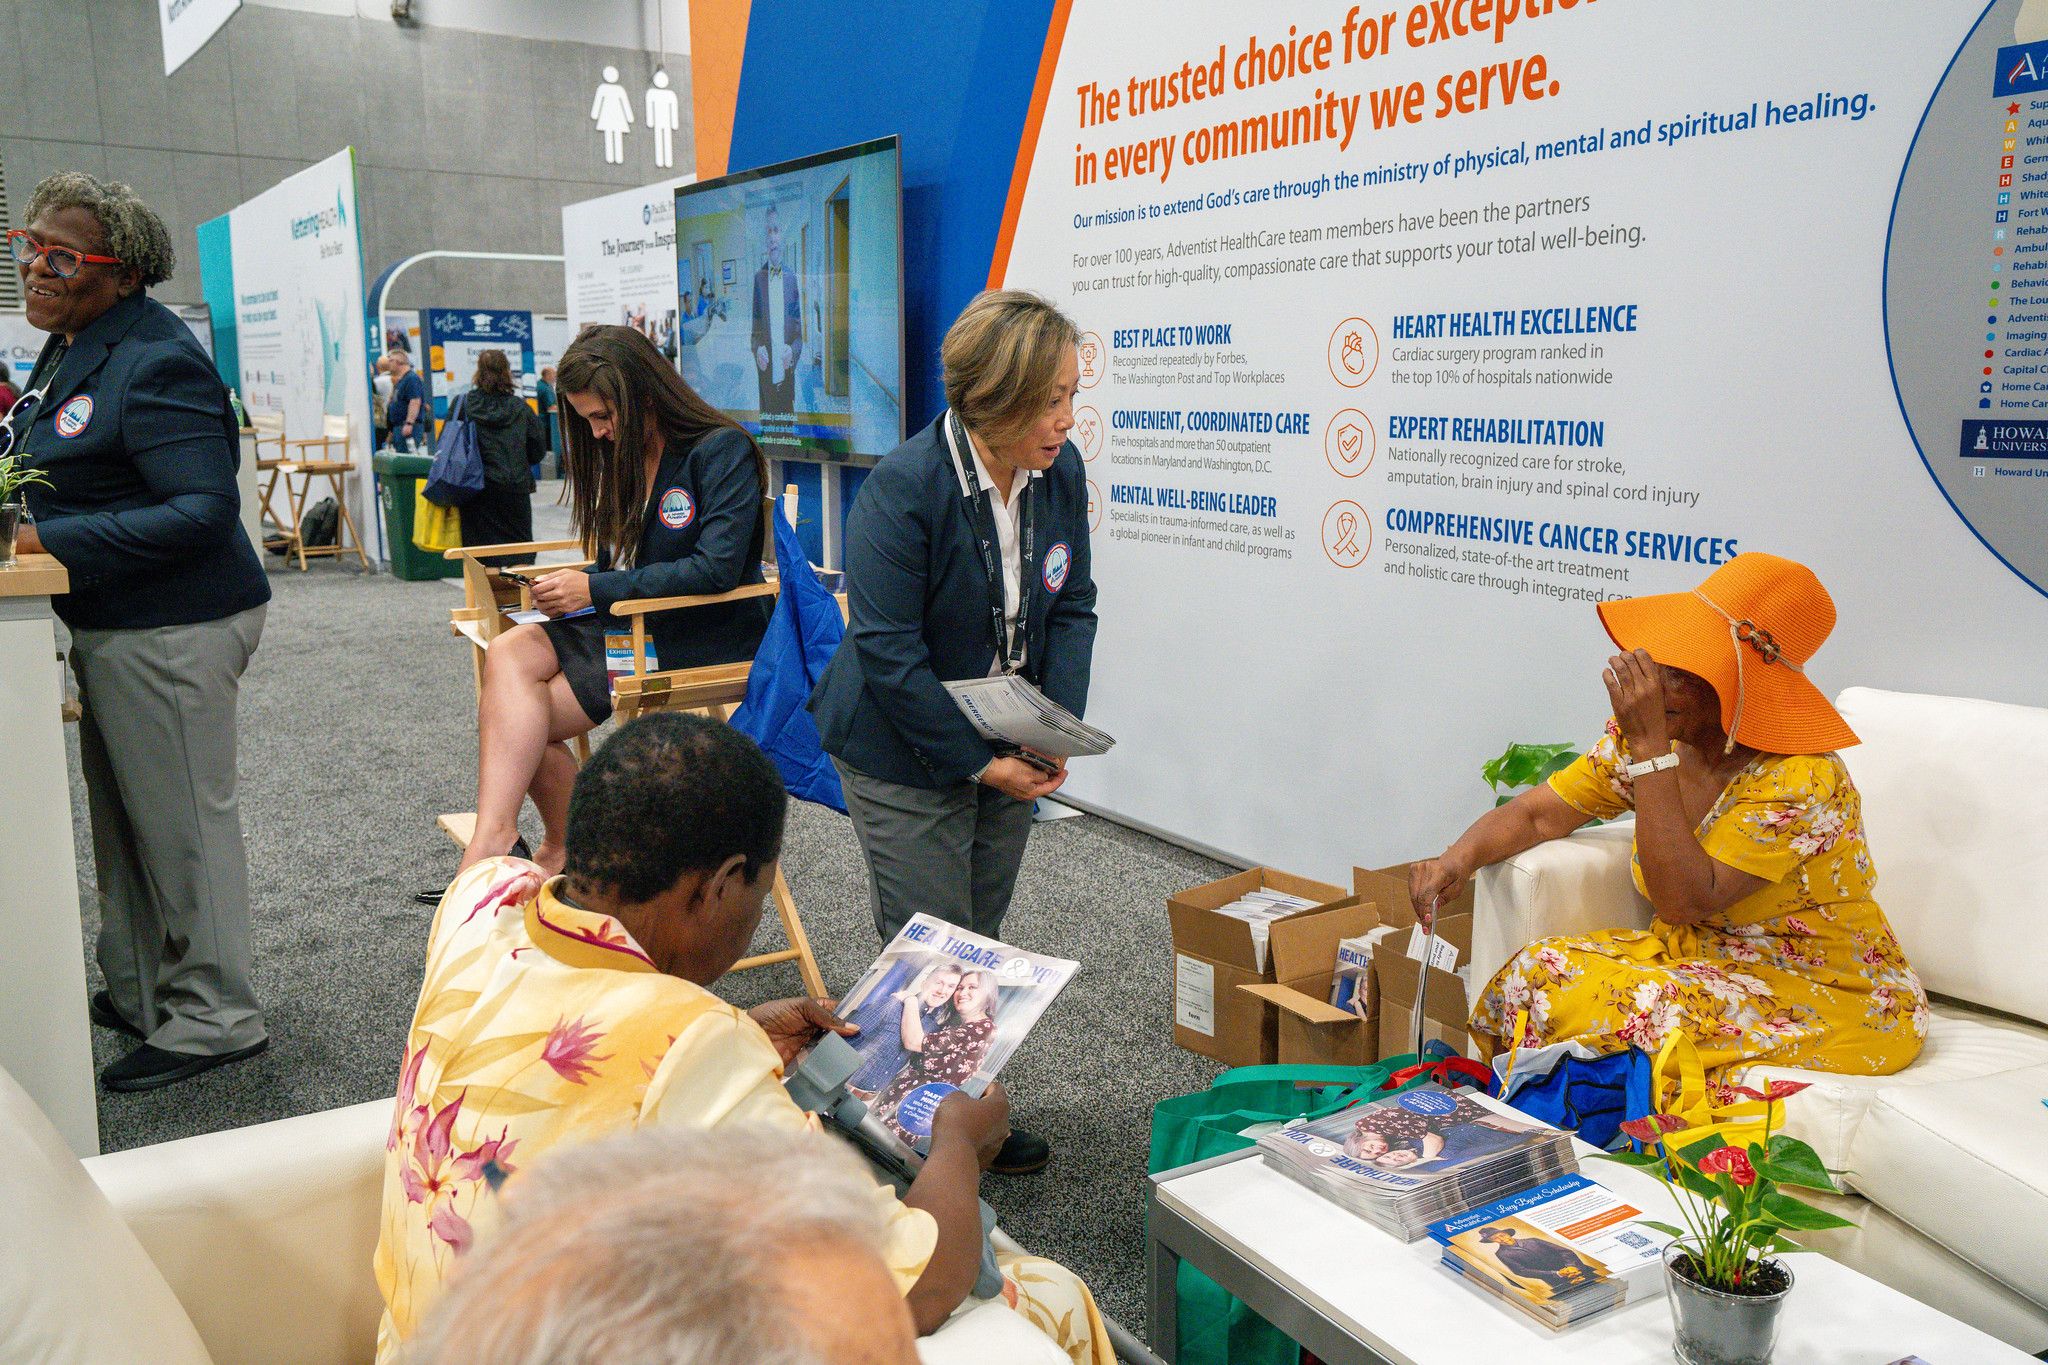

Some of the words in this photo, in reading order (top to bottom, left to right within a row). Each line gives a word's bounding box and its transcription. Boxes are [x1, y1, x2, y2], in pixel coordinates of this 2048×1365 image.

[1077, 81, 1120, 128] The
[1127, 44, 1226, 117] trusted
[1234, 25, 1332, 90] choice
[1342, 5, 1397, 64] for
[1406, 0, 1597, 48] excep
[1075, 143, 1097, 186] in
[1104, 135, 1176, 184] every
[1182, 90, 1361, 166] community
[1369, 81, 1425, 130] we
[1435, 54, 1560, 118] serve.
[1074, 214, 1093, 229] Our
[1095, 208, 1135, 226] mission
[1138, 204, 1146, 220] is
[1164, 193, 1203, 216] extend
[1206, 188, 1240, 209] God's
[1243, 188, 1270, 204] care
[1273, 174, 1330, 199] through
[1334, 170, 1359, 190] the
[1363, 162, 1429, 186] ministry
[1433, 153, 1451, 176] of
[1454, 141, 1530, 178] physical,
[1536, 128, 1604, 160] mental
[1610, 120, 1652, 149] and
[1658, 103, 1758, 146] spiritual
[1765, 92, 1876, 126] healing.
[2018, 208, 2039, 218] Fort
[1073, 254, 1088, 268] For
[1090, 254, 1112, 266] over
[1115, 248, 1132, 264] 100
[1134, 248, 1164, 266] years,
[1166, 238, 1217, 258] Adventist
[1220, 230, 1286, 251] HealthCare
[1289, 228, 1322, 244] team
[1326, 218, 1394, 240] members
[1398, 213, 1434, 232] have
[1439, 208, 1478, 228] been
[1483, 202, 1510, 222] the
[1515, 196, 1590, 224] partners
[602, 240, 616, 256] The
[616, 238, 645, 257] Journey
[1072, 281, 1090, 296] you
[1112, 274, 1135, 288] trust
[1137, 270, 1152, 286] for
[1155, 264, 1221, 288] high-quality,
[1224, 256, 1316, 280] compassionate
[1320, 255, 1348, 270] care
[1352, 248, 1381, 267] that
[1385, 243, 1452, 268] supports
[1456, 241, 1493, 264] your
[1497, 231, 1536, 254] total
[1541, 225, 1646, 250] well-being.
[2010, 297, 2028, 306] The
[1393, 314, 1446, 339] HEART
[1450, 310, 1516, 337] HEALTH
[1520, 304, 1638, 335] EXCELLENCE
[1114, 329, 1140, 349] BEST
[1142, 327, 1176, 348] PLACE
[1178, 326, 1193, 346] TO
[1195, 324, 1232, 345] WORK
[2006, 331, 2048, 342] Imaging
[1113, 354, 1158, 369] Recognized
[1160, 352, 1202, 368] repeatedly
[1216, 351, 1248, 365] Forbes,
[1392, 346, 1434, 361] Cardiac
[1436, 350, 1480, 364] surgery
[1483, 348, 1536, 364] program
[1540, 342, 1587, 360] ranked
[2004, 348, 2042, 358] Cardiac
[1128, 373, 1175, 387] Washington
[1178, 372, 1195, 384] Post
[1196, 371, 1212, 384] and
[1214, 372, 1230, 386] Top
[1232, 370, 1285, 386] Workplaces
[1392, 369, 1410, 384] the
[1412, 372, 1432, 387] top
[1436, 370, 1460, 384] 10%
[1462, 368, 1476, 384] of
[1477, 368, 1532, 388] hospitals
[1535, 368, 1612, 384] nationwide
[2003, 365, 2038, 376] Capital
[2002, 382, 2031, 392] Home
[2000, 399, 2030, 408] Home
[1112, 410, 1184, 434] CONVENIENT,
[1187, 411, 1272, 433] COORDINATED
[1276, 412, 1310, 434] CARE
[1389, 416, 1449, 440] EXPERT
[1452, 417, 1604, 448] REHABILITATION
[1127, 436, 1158, 450] hospitals
[1176, 440, 1196, 450] more
[1197, 438, 1214, 450] than
[1227, 440, 1271, 455] outpatient
[1111, 453, 1142, 465] locations
[1152, 455, 1186, 470] Maryland
[1188, 457, 1202, 469] and
[1204, 457, 1253, 474] Washington,
[1255, 460, 1272, 473] D.C.
[1388, 447, 1447, 467] Nationally
[1450, 452, 1518, 470] recognized
[1522, 457, 1550, 470] care
[1554, 454, 1574, 471] for
[1577, 457, 1625, 476] stroke,
[1994, 467, 2033, 478] Howard
[1111, 484, 1154, 506] MENTAL
[1157, 488, 1226, 512] WELL-BEING
[1229, 493, 1277, 518] LEADER
[1387, 472, 1458, 488] amputation,
[1462, 473, 1492, 489] brain
[1497, 476, 1533, 496] injury
[1536, 479, 1562, 494] and
[1566, 482, 1608, 500] spinal
[1613, 484, 1648, 500] cord
[1652, 486, 1700, 508] injury
[1111, 509, 1149, 524] Specialists
[1160, 515, 1228, 532] trauma-informed
[1230, 524, 1250, 536] care,
[1264, 525, 1283, 538] well
[1116, 527, 1140, 540] global
[1141, 530, 1171, 544] pioneer
[1182, 534, 1205, 548] infant
[1206, 538, 1223, 550] and
[1224, 539, 1246, 553] child
[1248, 545, 1292, 559] programs
[1386, 508, 1534, 546] COMPREHENSIVE
[1539, 522, 1618, 555] CANCER
[1624, 530, 1738, 566] SERVICES
[1385, 538, 1459, 562] Personalized,
[1462, 549, 1533, 570] state-of-the
[1536, 559, 1554, 572] art
[1558, 560, 1629, 582] treatment
[1384, 561, 1405, 575] and
[1408, 562, 1448, 581] holistic
[1451, 572, 1475, 584] care
[1478, 572, 1528, 595] through
[1532, 579, 1604, 602] integrated
[904, 922, 1004, 970] HEALTHCARE
[1029, 966, 1063, 986] YOU
[1329, 1154, 1424, 1186] HEALTHCARE
[1542, 1180, 1580, 1198] Scholarship
[1454, 1214, 1480, 1226] Adventist
